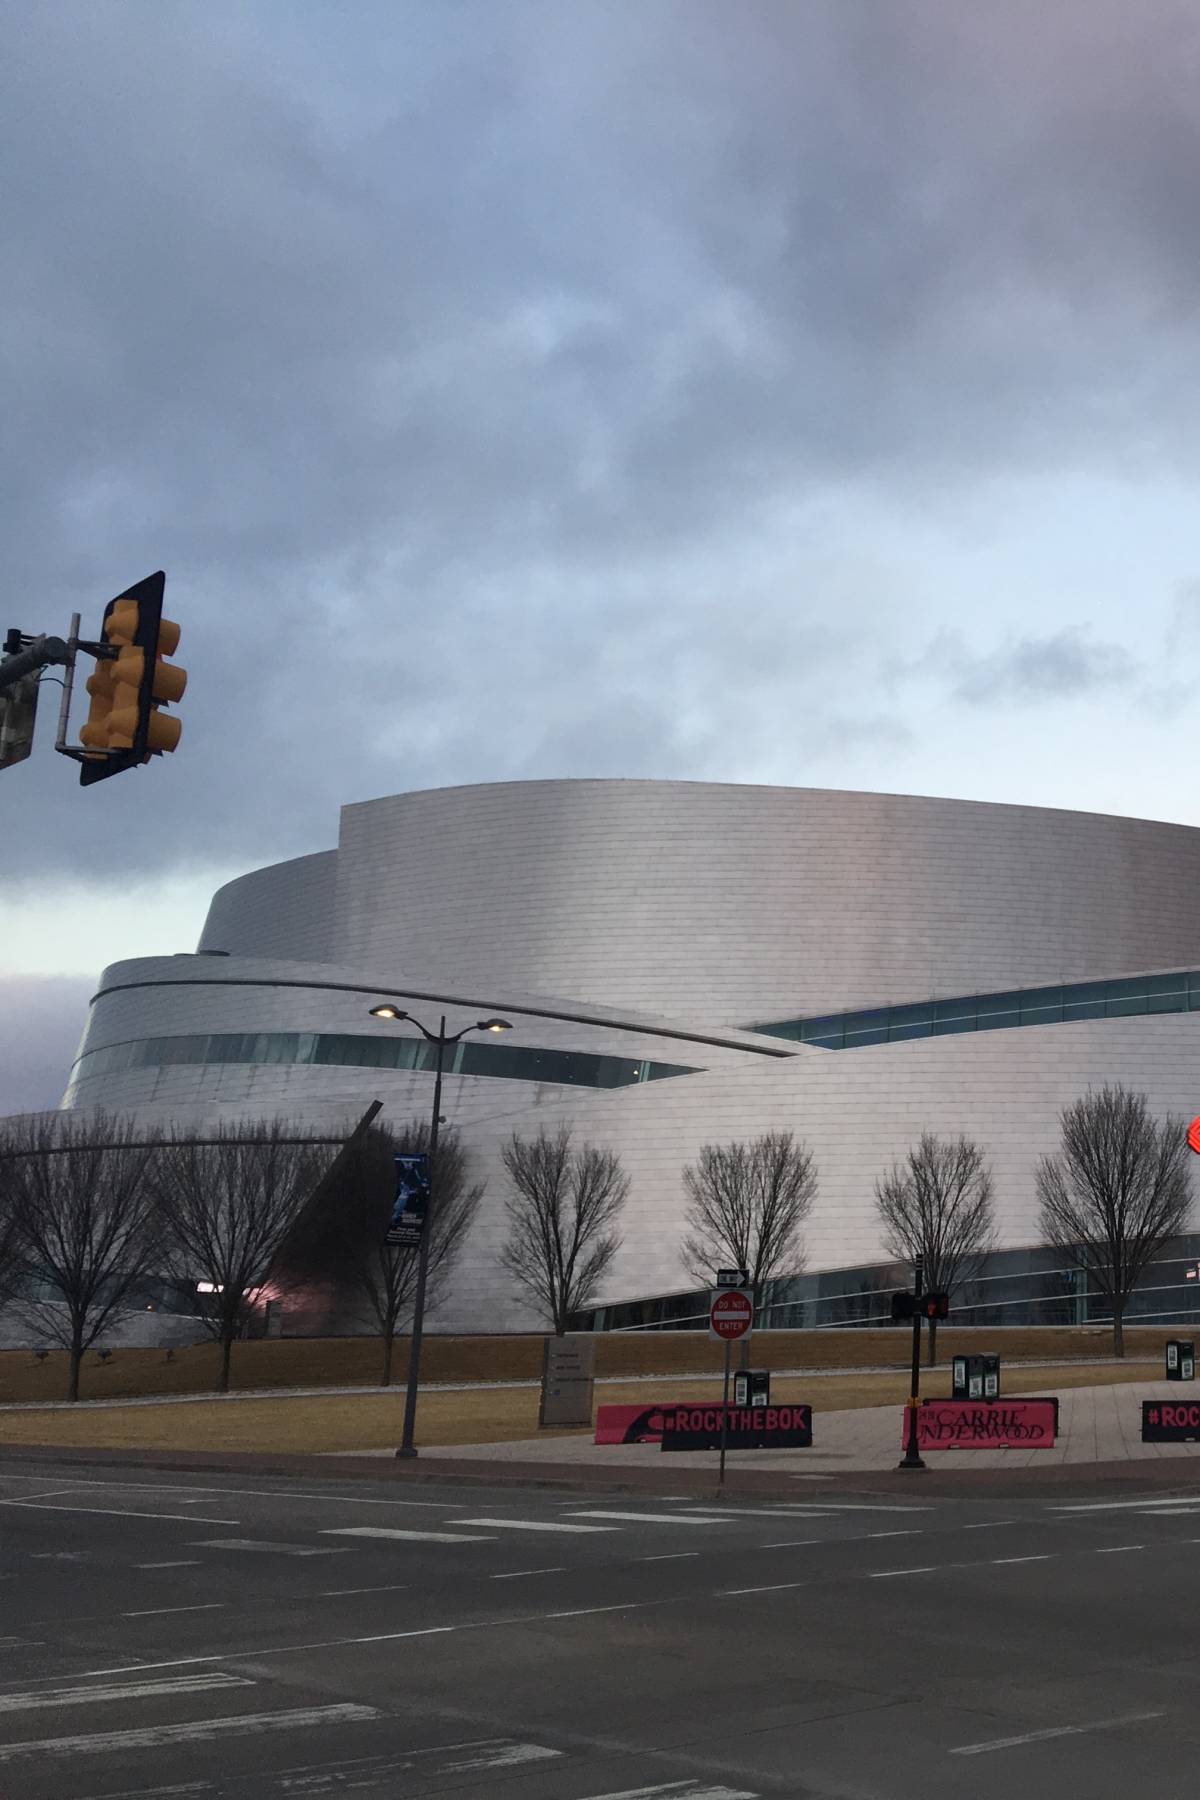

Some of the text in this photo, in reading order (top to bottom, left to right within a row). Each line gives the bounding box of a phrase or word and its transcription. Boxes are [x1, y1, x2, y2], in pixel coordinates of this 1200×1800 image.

[719, 1300, 746, 1309] DO NOT
[936, 1406, 1027, 1428] CARRIE
[918, 1423, 1045, 1444] NDERWOOD
